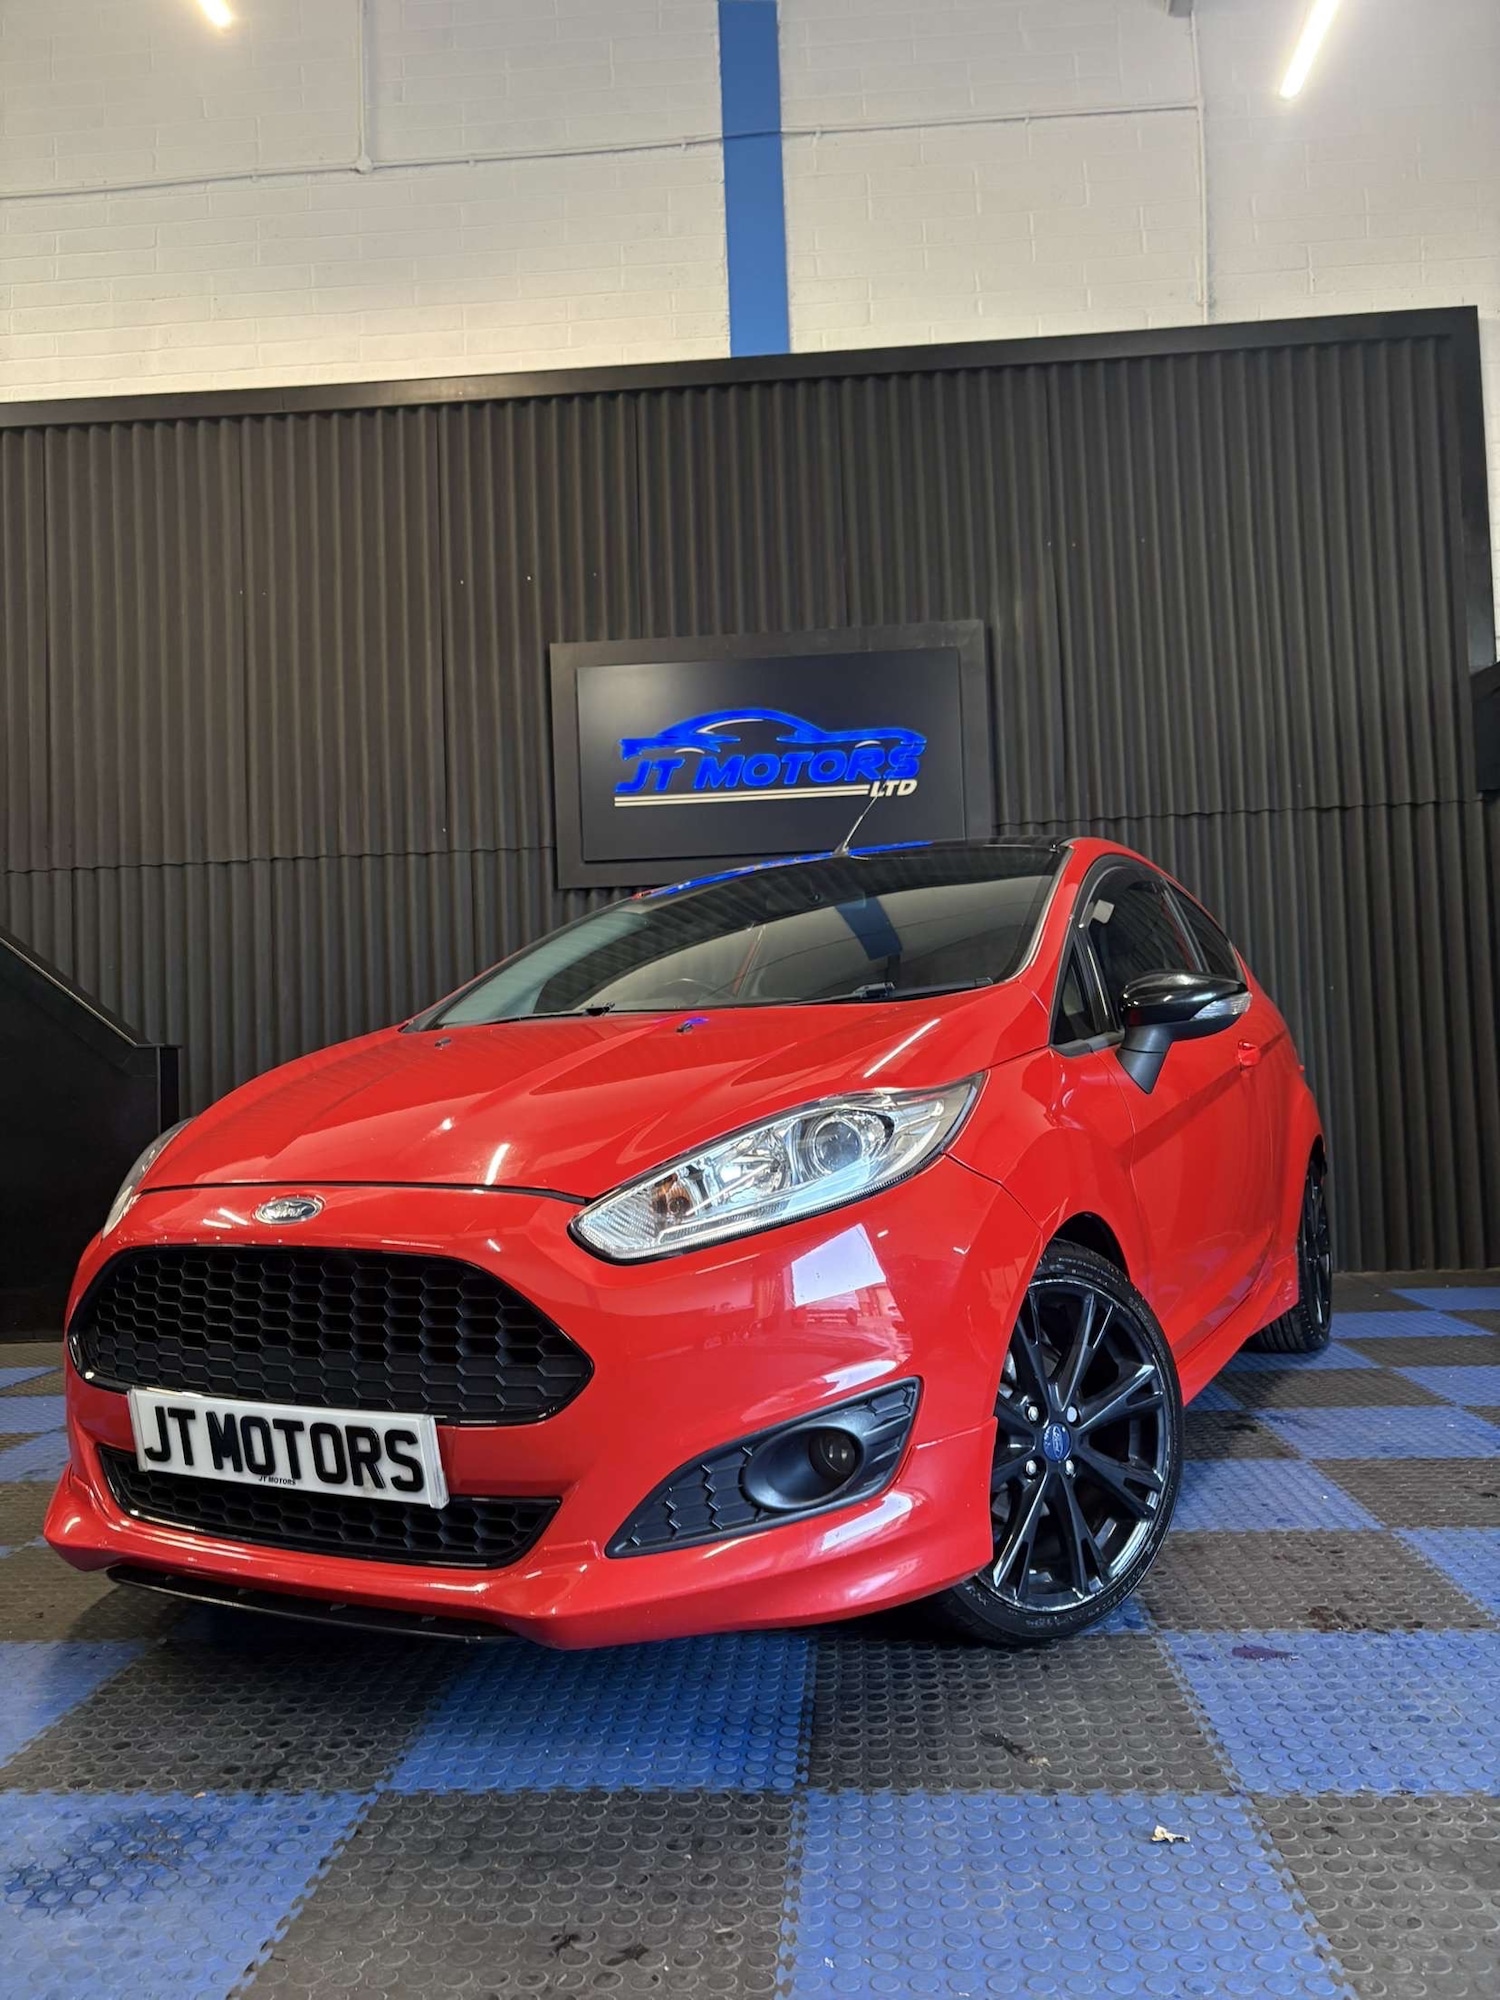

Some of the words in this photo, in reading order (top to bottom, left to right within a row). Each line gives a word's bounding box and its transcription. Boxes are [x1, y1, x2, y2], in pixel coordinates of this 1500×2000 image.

[614, 757, 686, 793] JT
[693, 745, 926, 790] MOTORS
[869, 779, 918, 798] LTD
[144, 1405, 197, 1467] JT
[206, 1410, 425, 1493] MOTORS
[258, 1475, 268, 1483] JT
[269, 1476, 297, 1486] MOTORS
